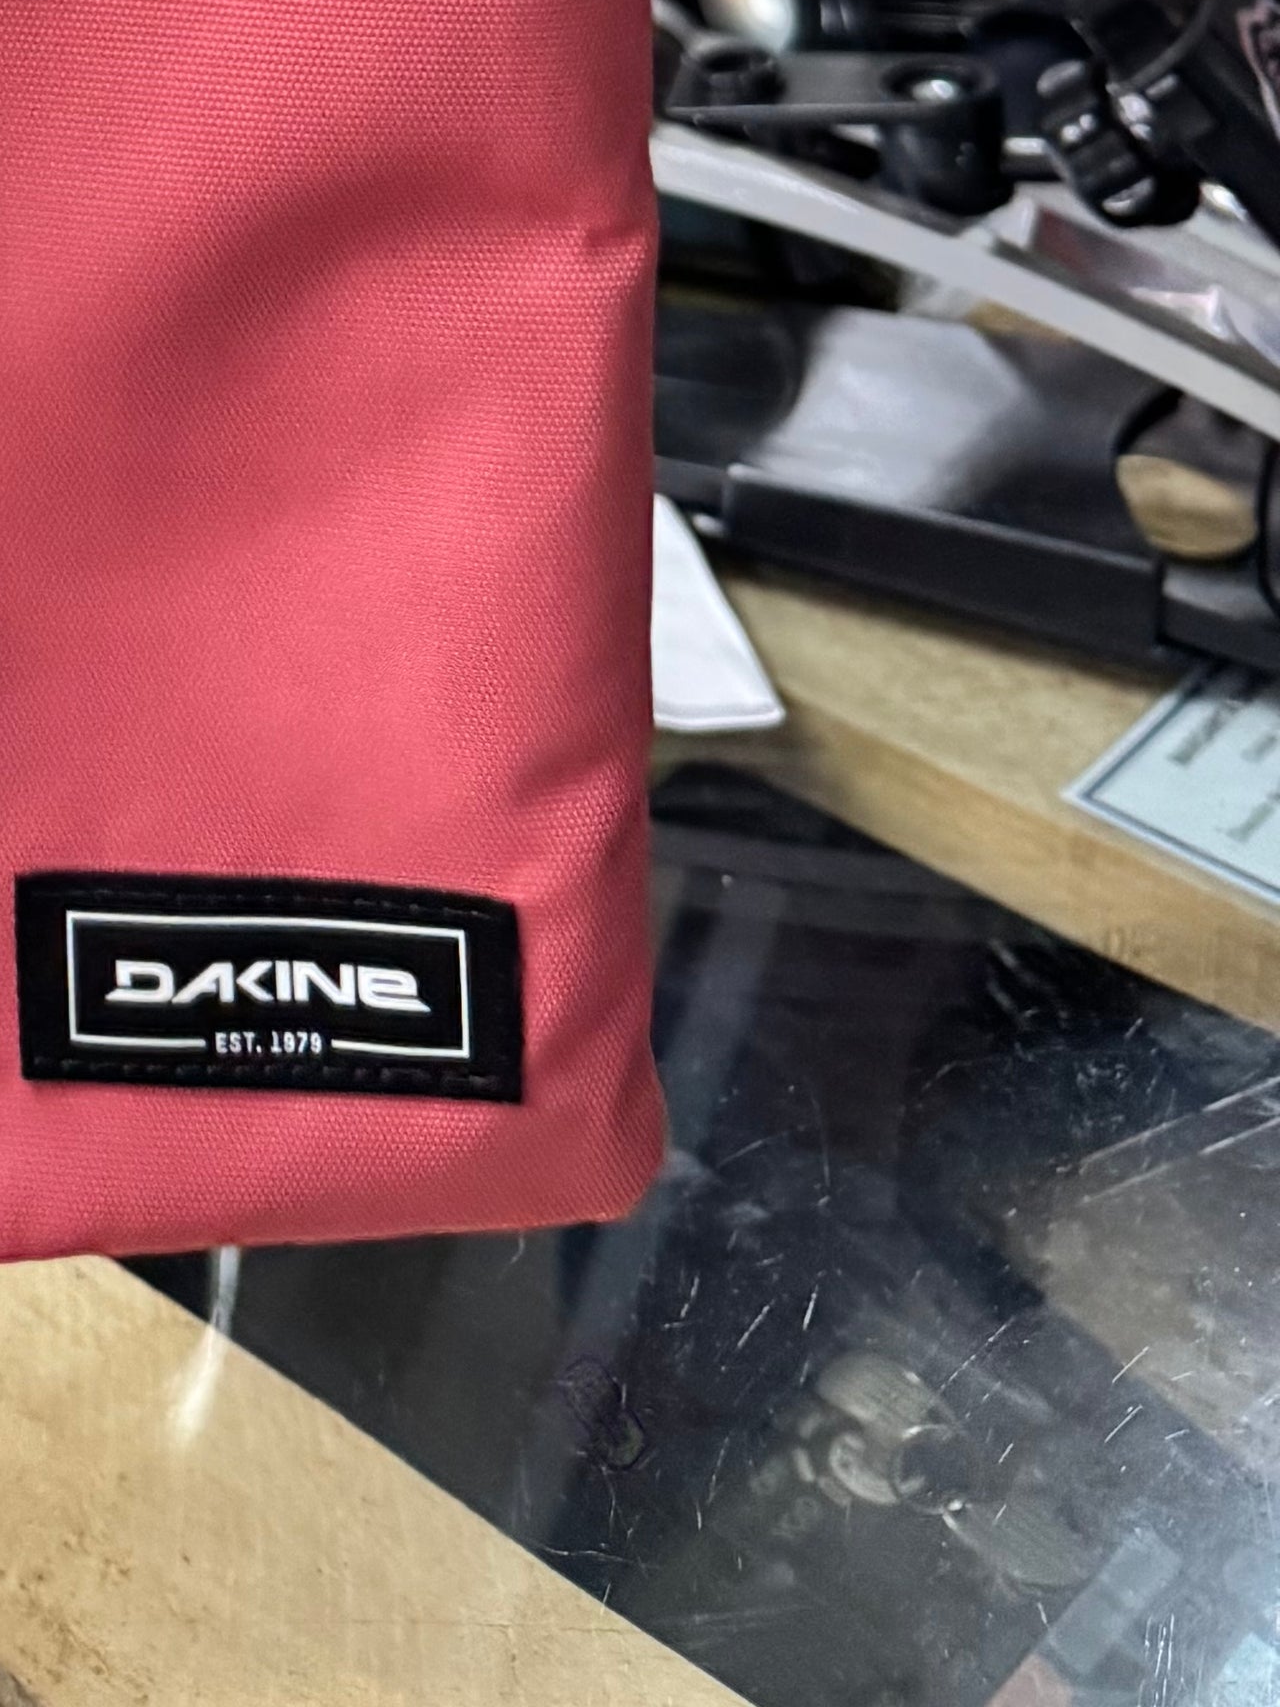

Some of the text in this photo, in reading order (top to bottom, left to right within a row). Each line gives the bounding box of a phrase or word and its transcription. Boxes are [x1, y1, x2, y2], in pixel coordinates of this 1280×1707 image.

[105, 959, 430, 1012] DAKINE
[215, 1030, 322, 1054] EST. 1979
